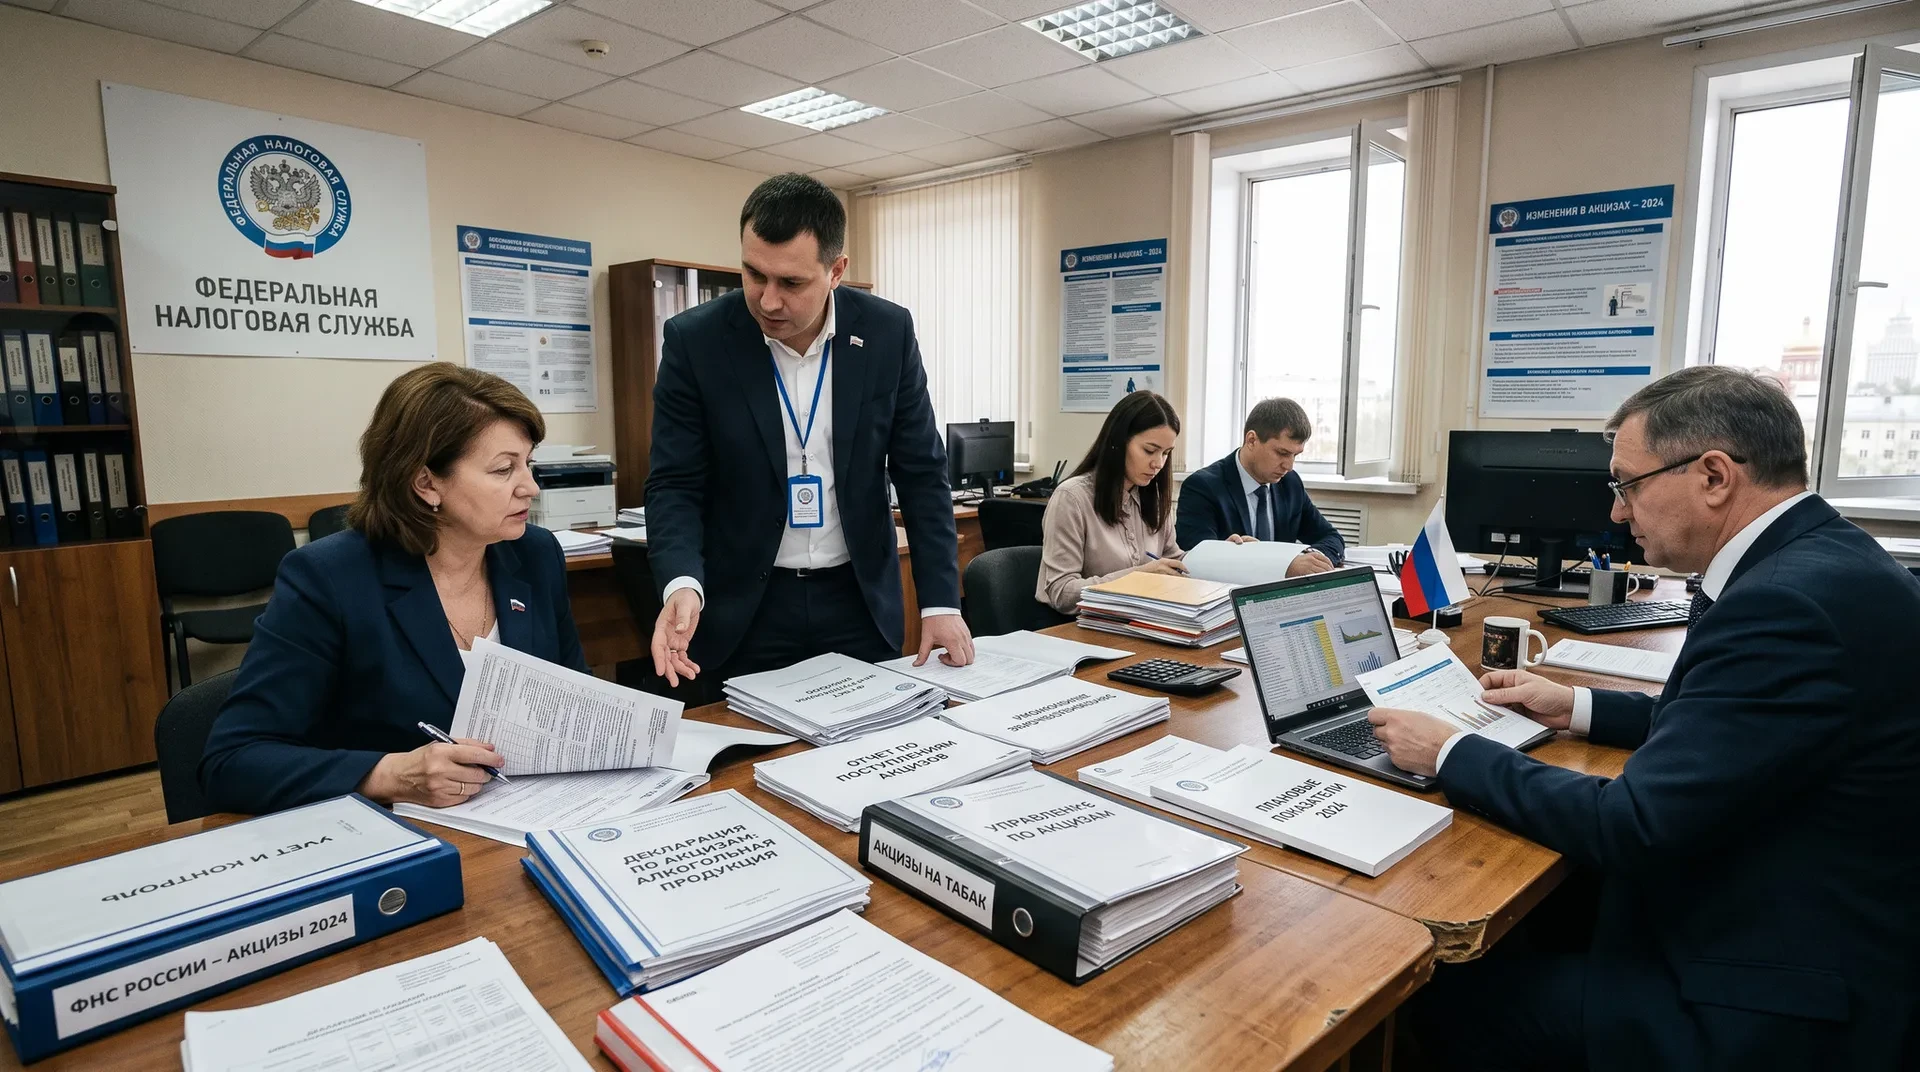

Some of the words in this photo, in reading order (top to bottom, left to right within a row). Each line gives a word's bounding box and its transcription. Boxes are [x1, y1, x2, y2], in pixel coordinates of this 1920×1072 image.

[222, 142, 259, 226] ФЕДЕРАЛЬНАЯ
[264, 139, 340, 185] НАЛОГОВАЯ
[328, 189, 348, 238] СЛУЖБА
[1526, 206, 1578, 220] ИЗМЕНЕНИЯ
[1580, 206, 1586, 215] В
[1588, 200, 1631, 214] АКЦИЗАХ
[1641, 197, 1664, 209] 2024
[195, 276, 379, 309] ФЕДЕРАЛЬНАЯ
[154, 304, 310, 333] НАЛОГОВАЯ
[318, 313, 415, 338] СЛУЖБА
[836, 740, 958, 782] ПОСТУПЛЕНИЯМ
[847, 748, 895, 767] ОТЧЕТ
[895, 742, 919, 752] ПО
[879, 753, 949, 780] АКЦИЗОВ
[1255, 778, 1322, 813] ПЛАНОВЫЕ
[1271, 782, 1348, 823] ПОКАЗАТЕЛИ
[1315, 801, 1349, 819] 2024
[623, 824, 747, 866] ДЕКЛАРАЦИЯ
[1006, 829, 1036, 842] ПО
[1039, 811, 1116, 836] АКЦИЗАМ
[249, 853, 270, 863] И
[630, 861, 659, 874] ПО
[665, 833, 759, 865] АКЦИЗАМ:
[637, 838, 777, 886] АЛКОГОЛЬНАЯ
[660, 850, 779, 892] ПРОДУКЦИЯ
[100, 859, 245, 903] КОНТРОЛЬ
[873, 839, 923, 876] АКЦИЗЫ
[925, 864, 942, 887] НА
[945, 875, 988, 911] ТАБАК
[70, 987, 120, 1015] ФНС
[125, 957, 208, 998] РОССИИ
[227, 925, 305, 963] АКЦИЗЫ
[309, 910, 349, 936] 2024
